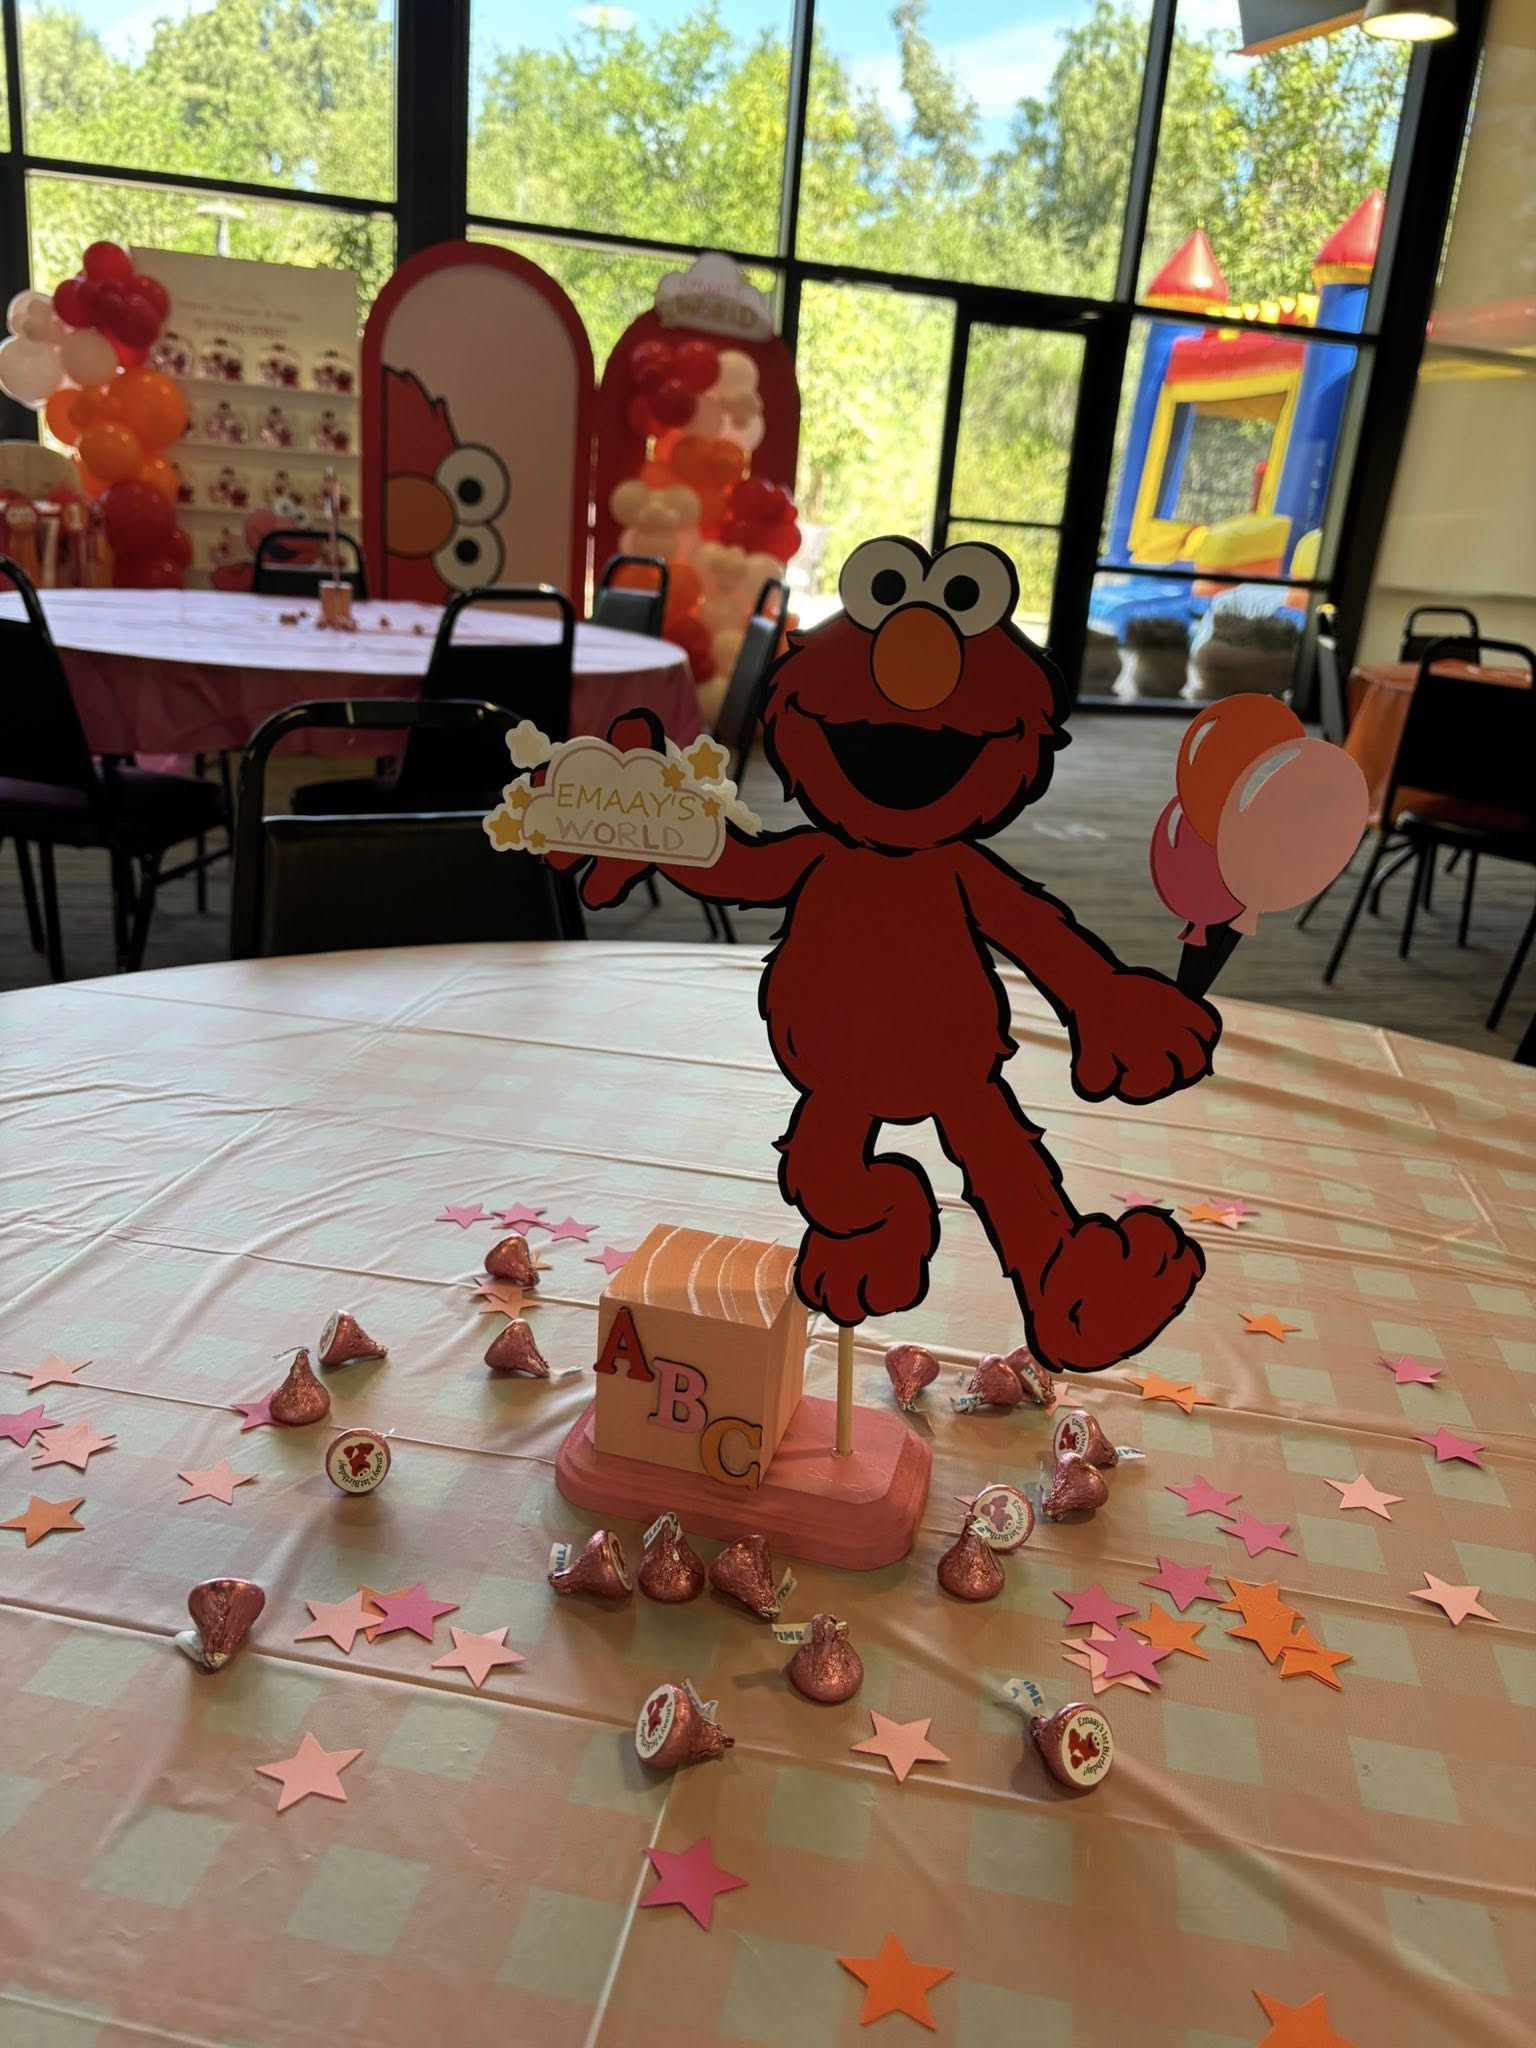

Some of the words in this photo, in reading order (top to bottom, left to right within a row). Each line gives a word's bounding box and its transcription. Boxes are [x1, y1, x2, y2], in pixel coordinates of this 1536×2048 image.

[556, 783, 697, 821] EMAAY'S
[556, 816, 684, 851] WORLD
[1077, 1716, 1105, 1734] Emaay's
[1083, 1745, 1111, 1776] Birthday!
